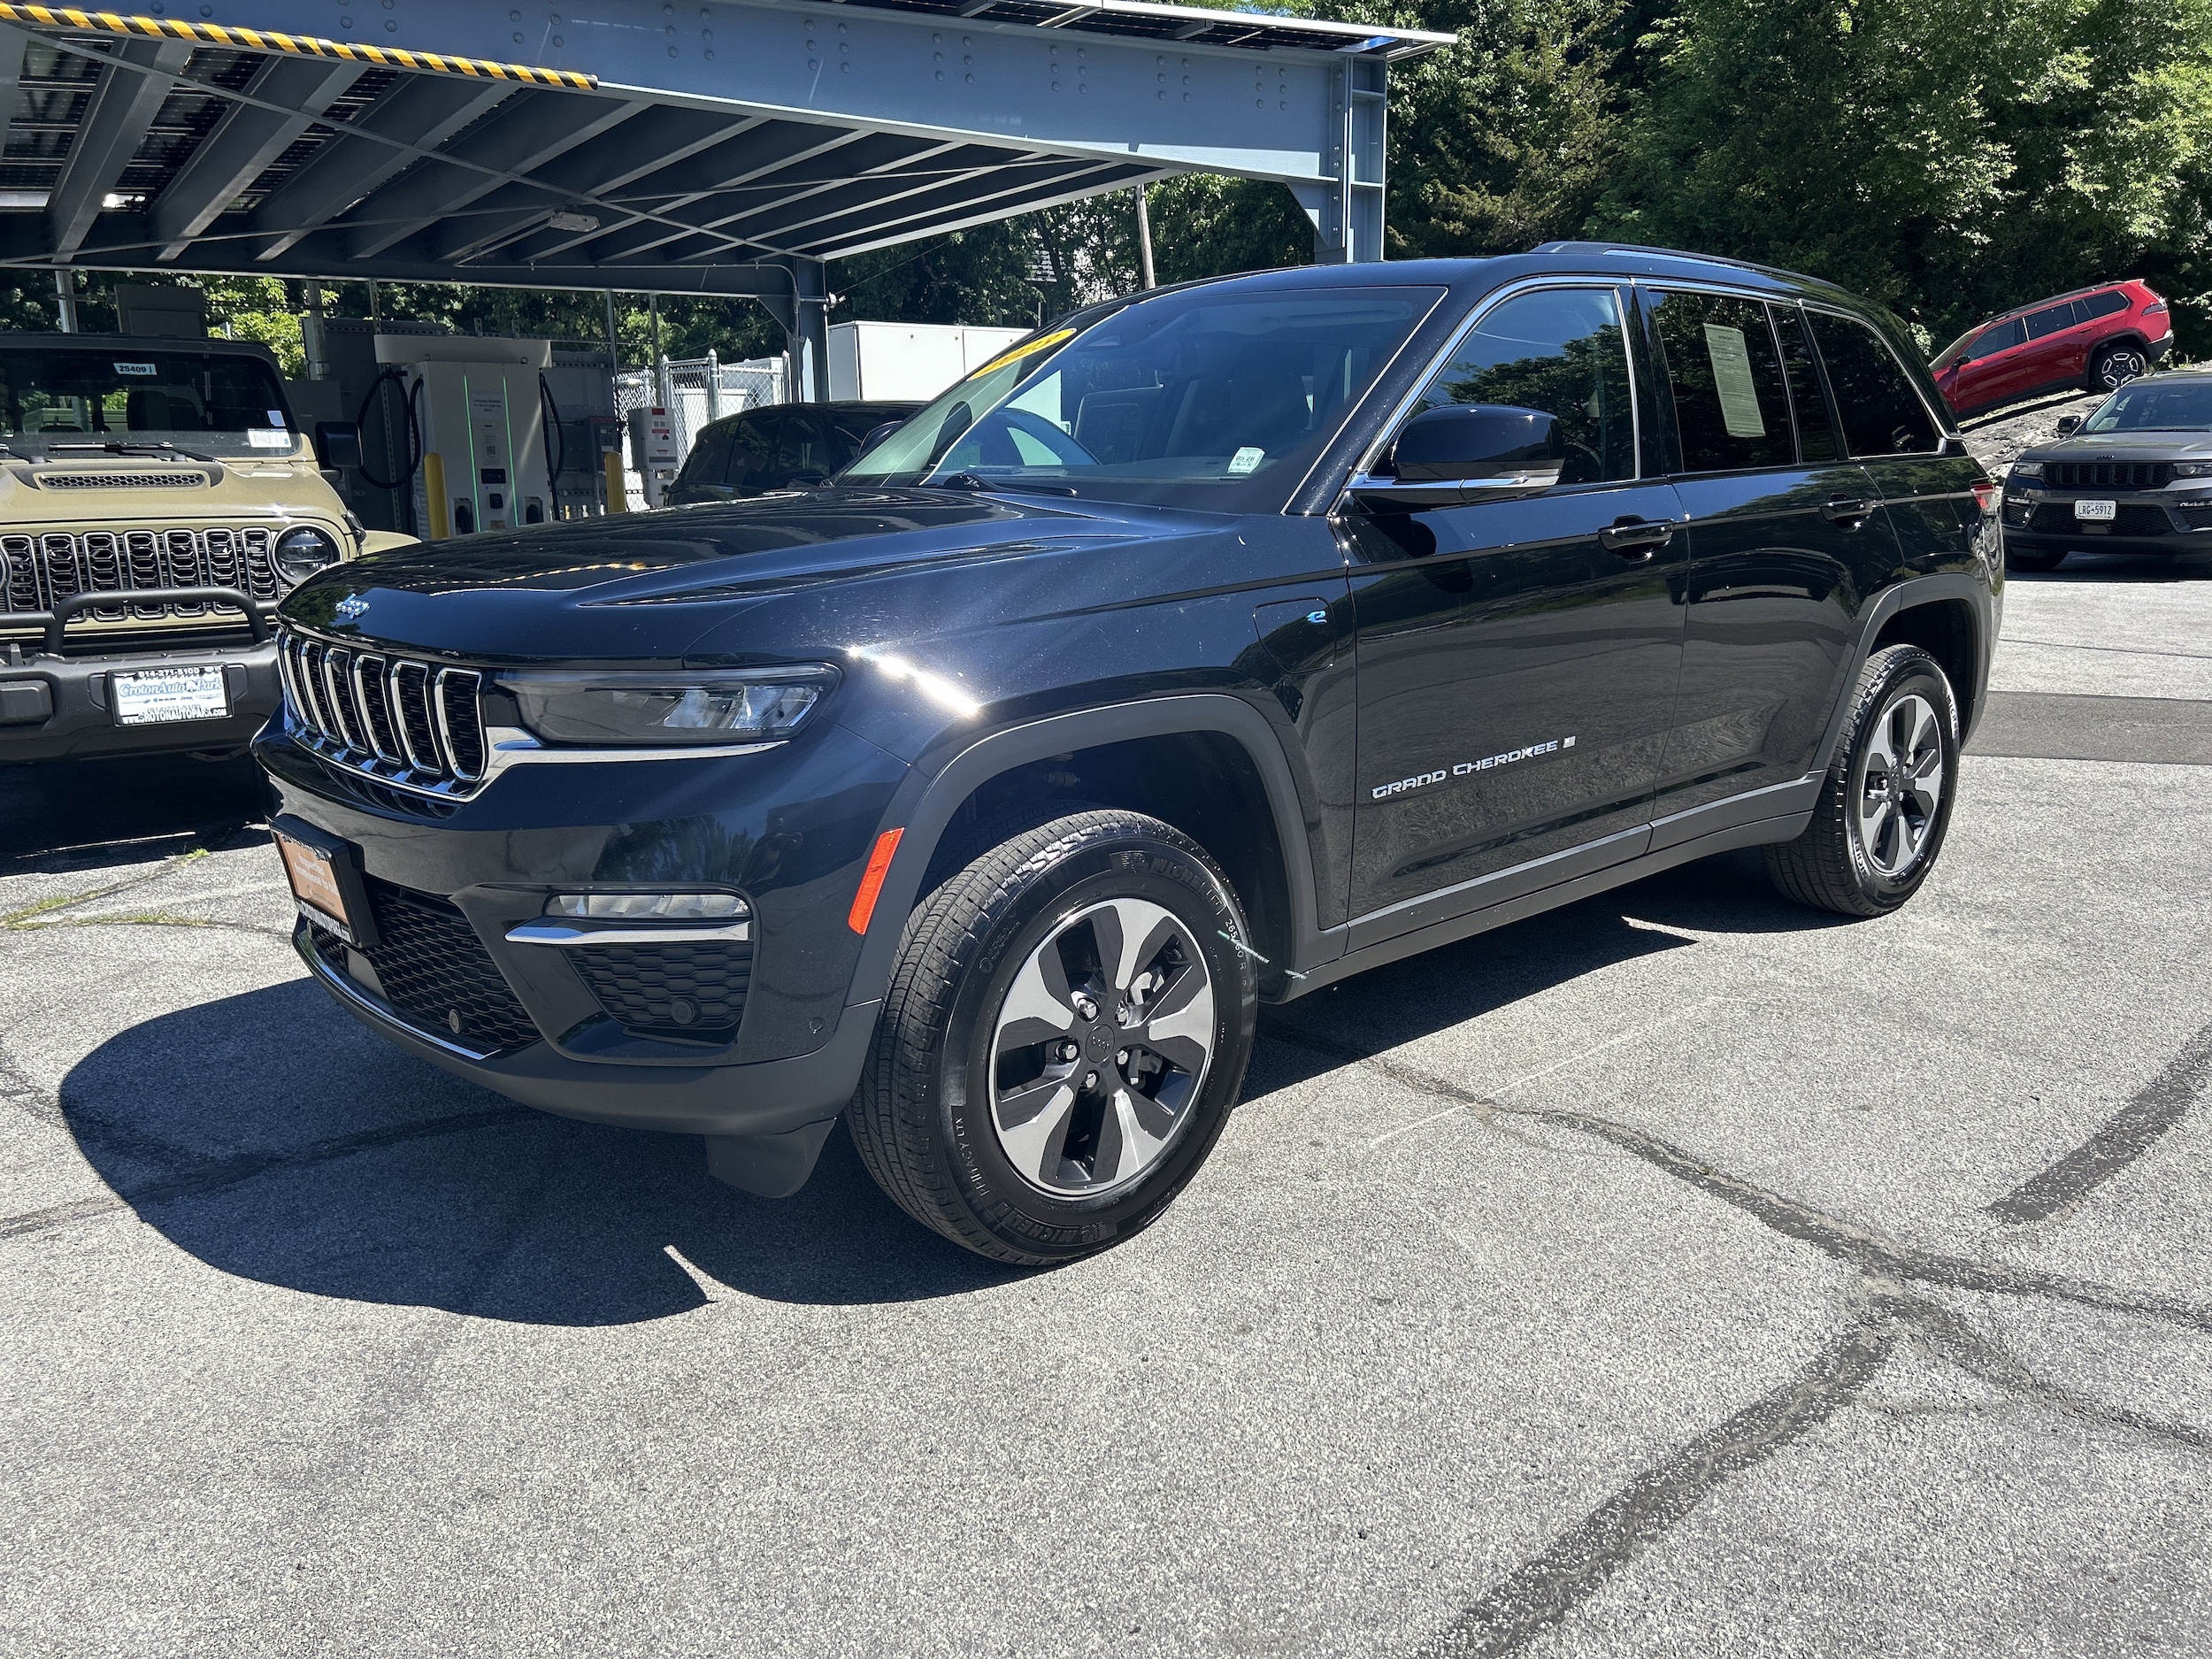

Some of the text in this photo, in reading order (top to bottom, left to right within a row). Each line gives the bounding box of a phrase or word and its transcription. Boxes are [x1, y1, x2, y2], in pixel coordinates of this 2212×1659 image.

[137, 666, 201, 678] 914-271-5100
[196, 677, 223, 692] Park
[1371, 739, 1559, 800] GRAND CHEROKEE
